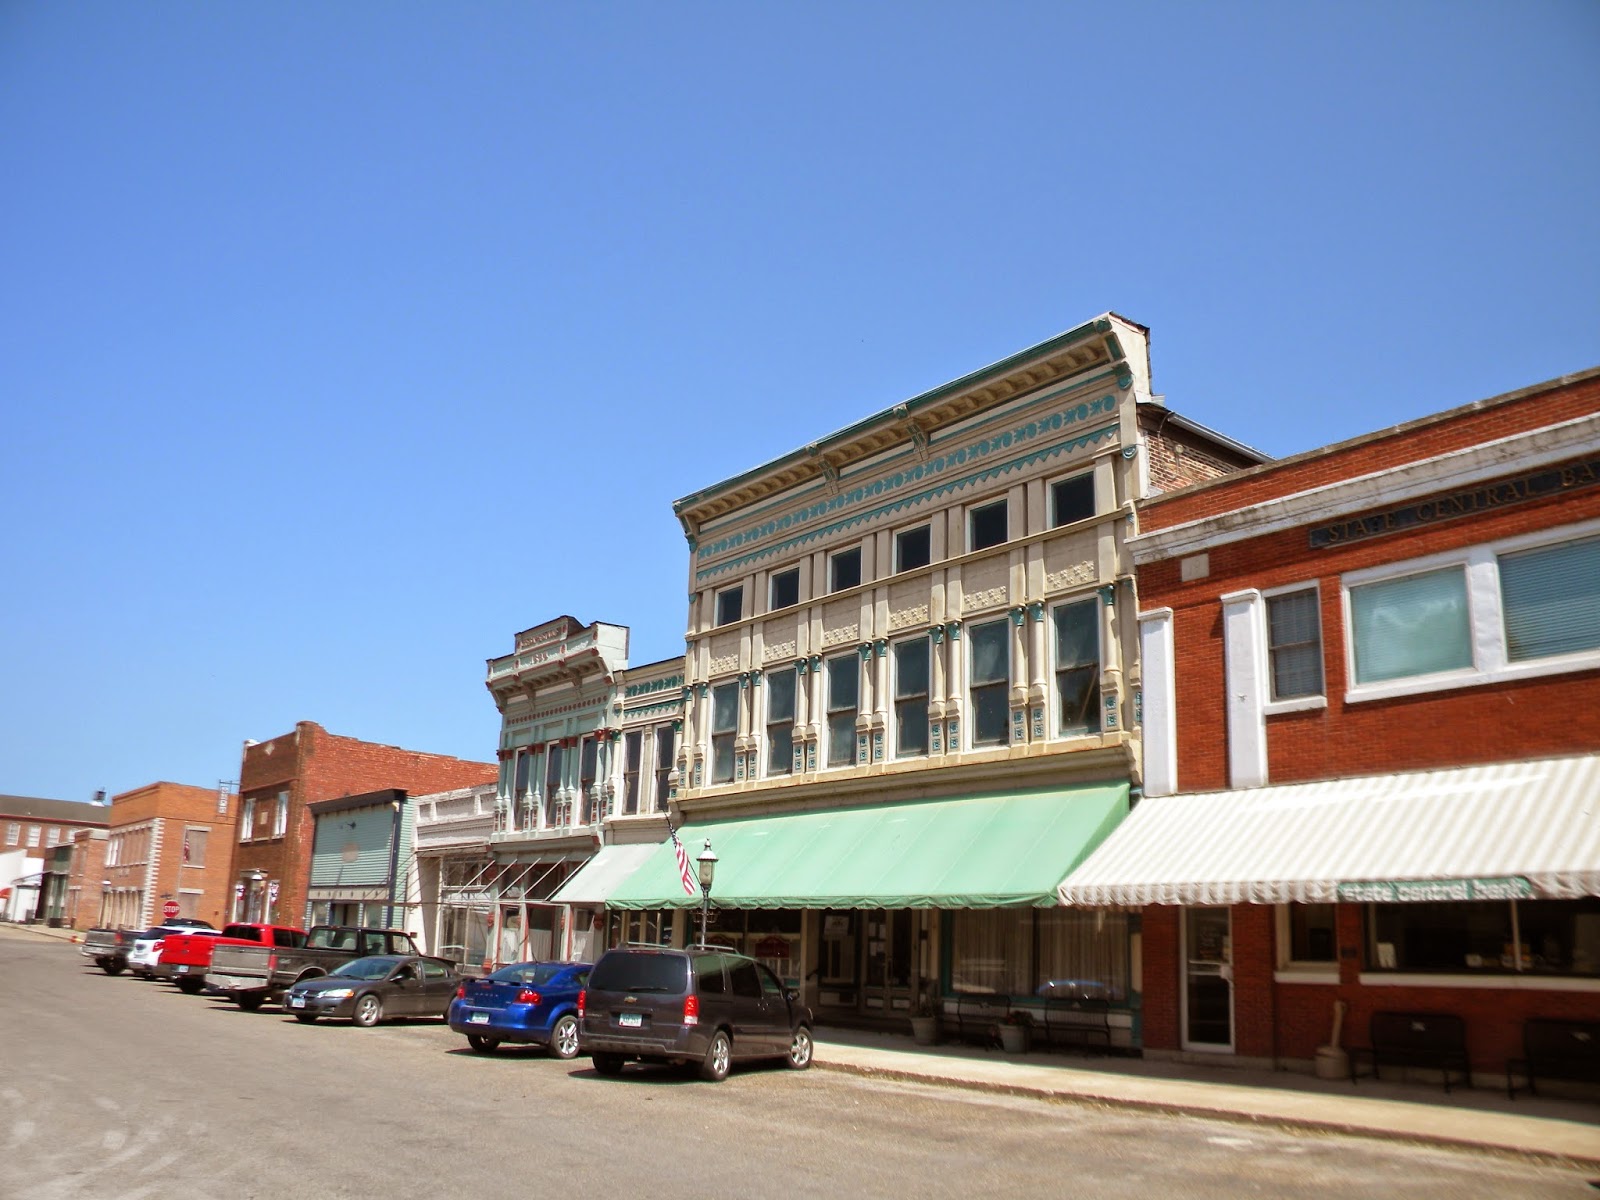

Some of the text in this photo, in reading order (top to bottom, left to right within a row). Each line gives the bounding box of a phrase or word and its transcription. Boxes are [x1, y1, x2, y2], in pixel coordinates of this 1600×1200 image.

[1328, 513, 1397, 542] STATE
[1417, 480, 1536, 521] CENTRAL
[1343, 878, 1526, 903] state central bank
